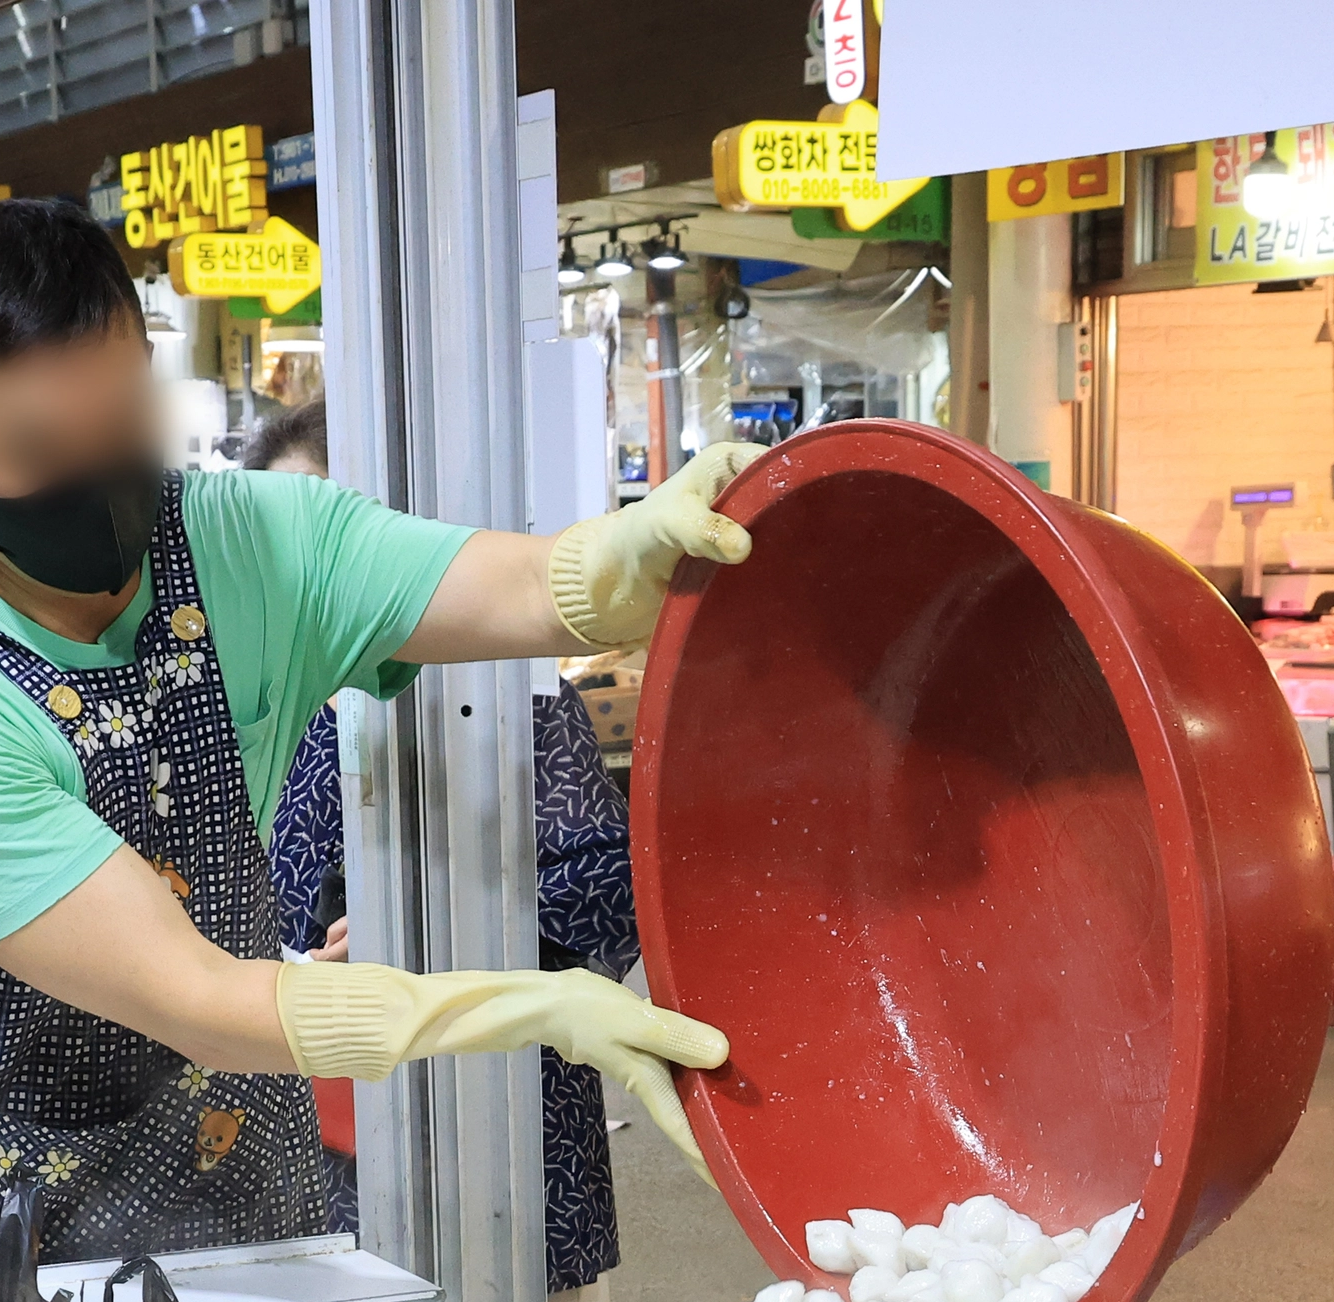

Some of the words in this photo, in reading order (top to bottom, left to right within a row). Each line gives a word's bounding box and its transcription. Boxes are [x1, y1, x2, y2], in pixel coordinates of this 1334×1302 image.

[753, 131, 828, 172] 쌍화차
[120, 124, 253, 249] 동산건어물
[762, 177, 889, 200] 010-8008-6881
[196, 242, 310, 272] 동산건어물
